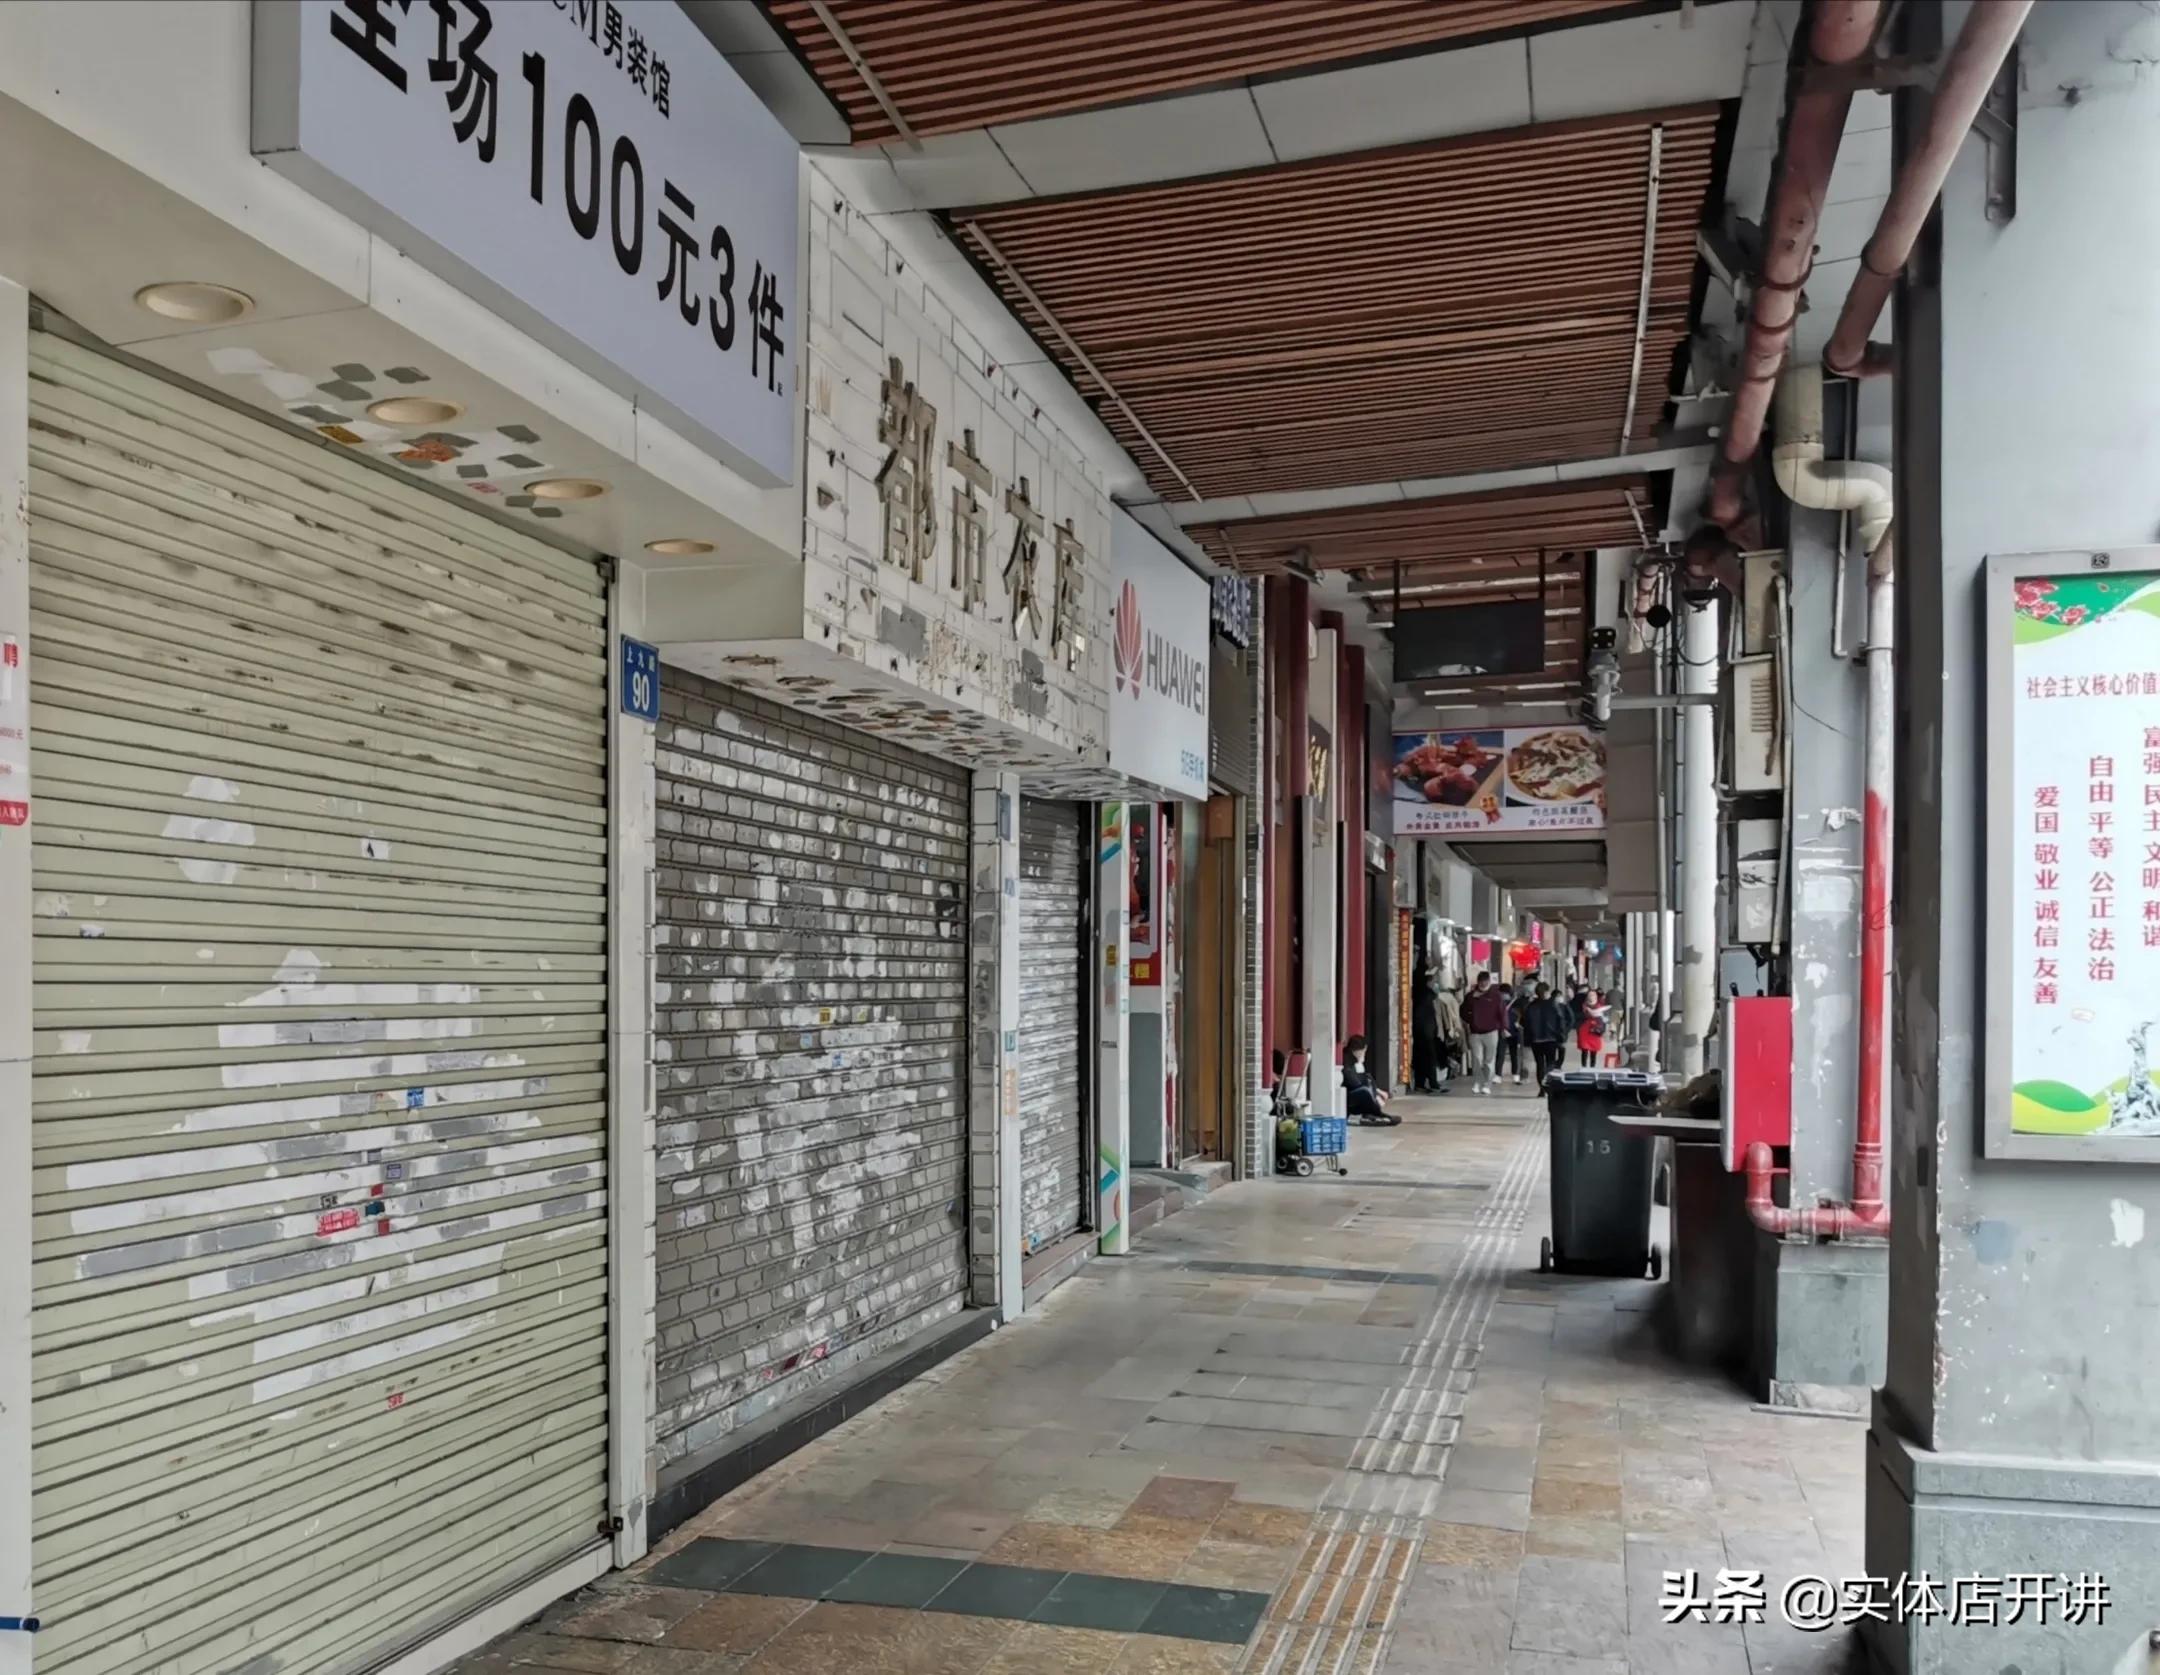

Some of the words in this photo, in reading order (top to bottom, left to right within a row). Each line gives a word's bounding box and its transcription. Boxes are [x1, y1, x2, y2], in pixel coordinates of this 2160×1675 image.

[632, 671, 650, 712] 90
[1146, 629, 1206, 716] HUAWEI
[2026, 671, 2160, 699] 社会主义核心价值
